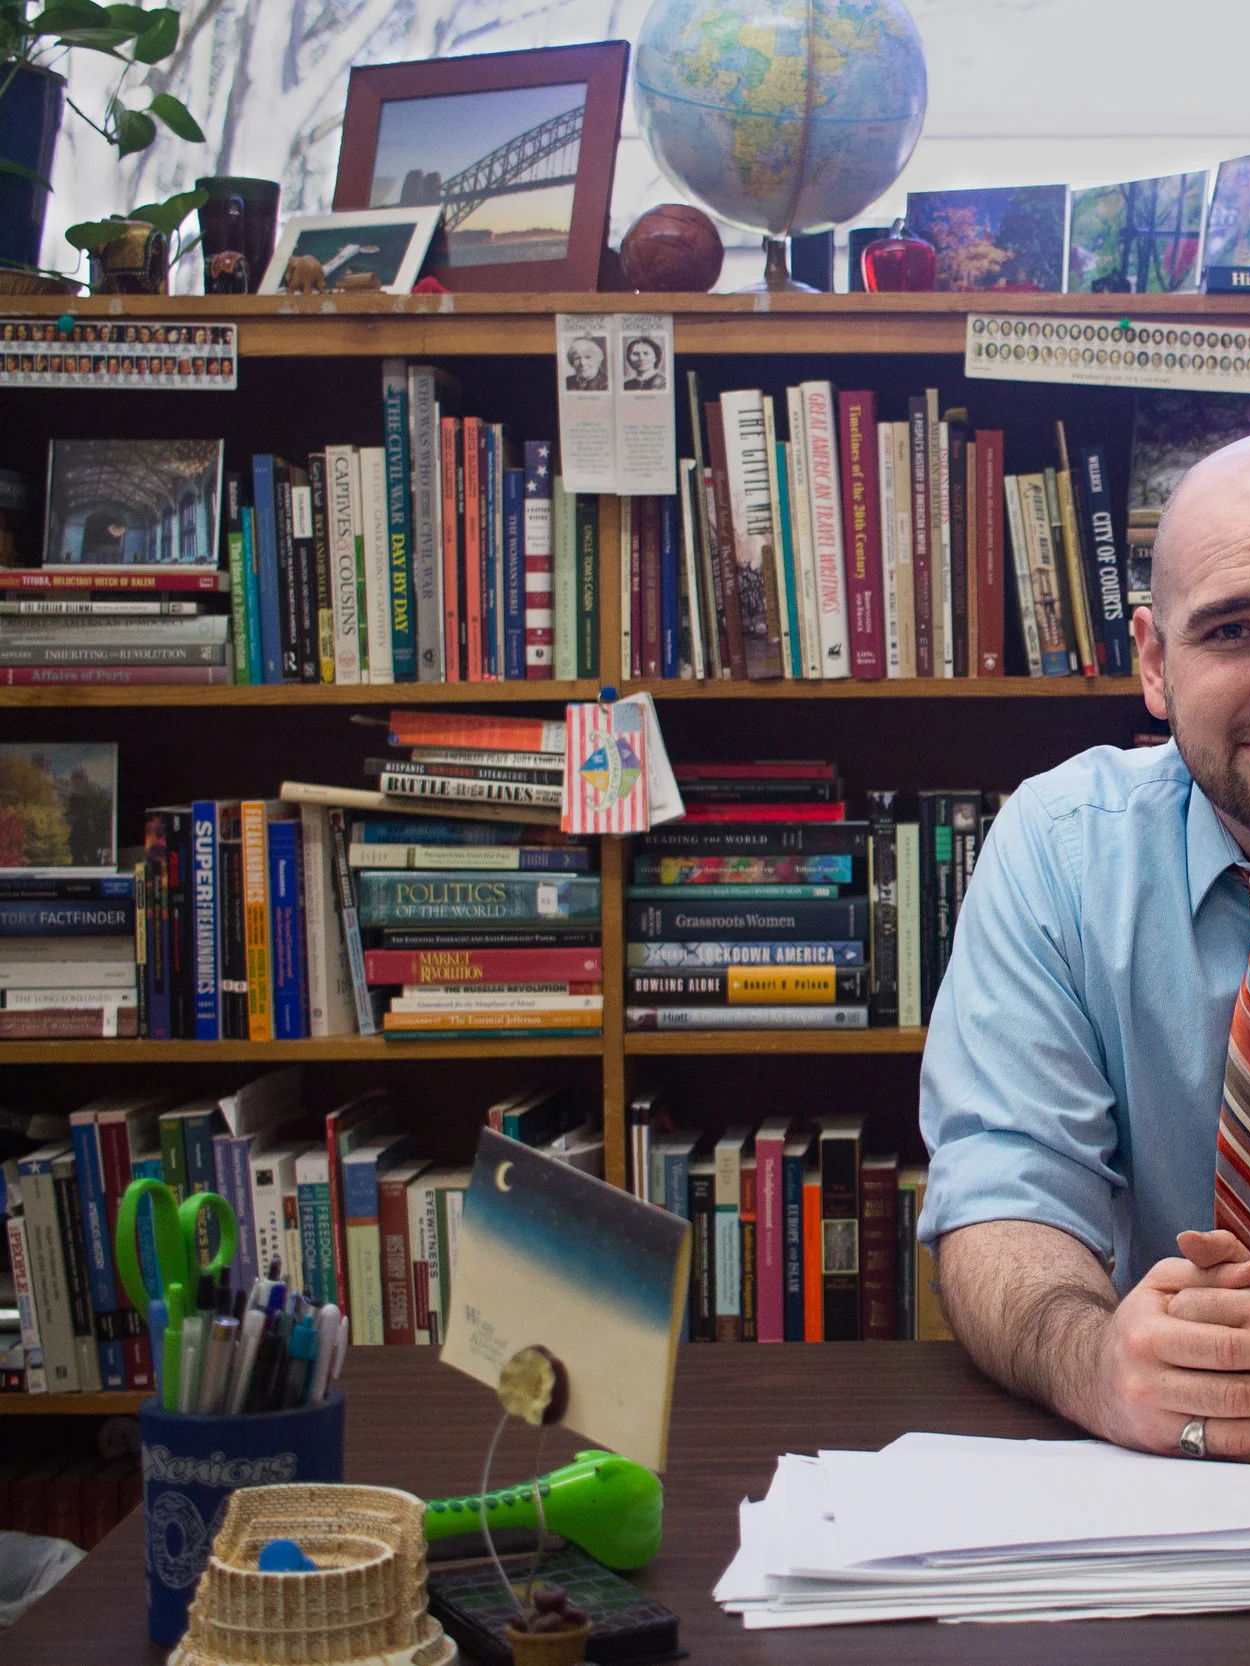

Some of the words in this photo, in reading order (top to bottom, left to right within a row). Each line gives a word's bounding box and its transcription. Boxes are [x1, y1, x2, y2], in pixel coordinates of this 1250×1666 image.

[417, 376, 431, 413] WHO
[387, 398, 401, 432] THE
[737, 408, 766, 441] THE
[807, 392, 828, 432] GREAT
[418, 415, 431, 446] WAS
[849, 404, 862, 462] Timelines
[914, 420, 924, 450] PEOPLE'S
[388, 433, 403, 483] CIVIL
[420, 449, 432, 487] WHO
[741, 448, 770, 497] CIVIL
[811, 435, 832, 500] AMERICAN
[851, 464, 864, 479] of
[915, 452, 925, 482] HISTORY
[916, 483, 925, 493] OF
[1087, 455, 1103, 493] WILLRICH
[390, 484, 405, 524] WAR
[852, 482, 864, 500] the
[508, 515, 518, 535] THE
[745, 502, 773, 537] WAR
[815, 505, 836, 547] TRAVEL
[853, 504, 866, 531] 20th
[916, 494, 926, 528] AMERICAN
[420, 521, 434, 562] CIVIL
[583, 524, 593, 552] UNCLE
[917, 530, 927, 555] EMPIRE
[1093, 511, 1113, 543] CITY
[231, 542, 242, 560] The
[391, 532, 406, 568] DAY
[508, 537, 519, 587] WOMAN'S
[854, 533, 868, 580] Century
[1096, 545, 1116, 564] OF
[53, 576, 92, 586] RELUCTANT
[94, 576, 118, 586] WITCH
[120, 577, 129, 585] OF
[131, 576, 156, 586] SALEM
[338, 554, 356, 636] COUSINS
[392, 571, 407, 595] BY
[422, 565, 434, 600] WAR
[819, 553, 841, 614] WRITINGS
[1100, 566, 1123, 621] COURTS
[509, 588, 519, 615] BIBLE
[583, 583, 594, 612] CABIN
[394, 598, 408, 634] DAY
[44, 649, 109, 660] INHERITING
[119, 649, 187, 659] REVOLUTION
[32, 670, 77, 681] Affairs
[81, 670, 93, 681] of
[96, 670, 132, 682] Party
[385, 762, 425, 774] HISPANIC
[427, 766, 474, 776] IMMIGRANT
[479, 769, 528, 782] LITERATURE
[387, 776, 450, 796] BATTLE
[486, 784, 534, 802] LINES
[646, 835, 698, 844] READING
[704, 836, 720, 844] THE
[725, 835, 768, 844] WORLD
[245, 808, 265, 904] FREAKONOMICS
[195, 820, 214, 994] SUPERFREAKONOMICS
[395, 882, 506, 904] POLITICS
[39, 911, 126, 925] FACTFINDER
[395, 904, 424, 918] OF
[425, 904, 449, 918] THE
[450, 904, 507, 918] WORLD
[675, 914, 745, 928] Grassroots
[746, 914, 796, 928] Women
[420, 951, 472, 966] MARKET
[703, 947, 770, 962] LOCKDOWN
[776, 947, 835, 962] AMERICA
[420, 965, 483, 983] REVOLUTION
[444, 986, 461, 994] THE
[463, 985, 505, 993] RUSSIAN
[507, 984, 567, 993] REVOLUTION
[635, 978, 684, 993] BOWLING
[689, 978, 721, 993] ALONE
[743, 980, 776, 990] Robert
[795, 980, 829, 990] Putnam
[449, 1014, 466, 1024] The
[468, 1014, 504, 1024] Essential
[505, 1014, 542, 1025] Jefferson
[662, 1011, 688, 1023] Hiatt
[765, 1158, 774, 1172] The
[764, 1173, 774, 1229] Enlightenment
[303, 1206, 317, 1270] FREEDOM
[319, 1206, 333, 1269] FREEDOM
[425, 1190, 438, 1279] EYEWITNESS
[787, 1204, 799, 1244] EUROPE
[10, 1231, 29, 1294] PEOPLE
[385, 1234, 406, 1279] HISTORY
[788, 1262, 799, 1293] ISLAM
[388, 1281, 409, 1329] LESSONS
